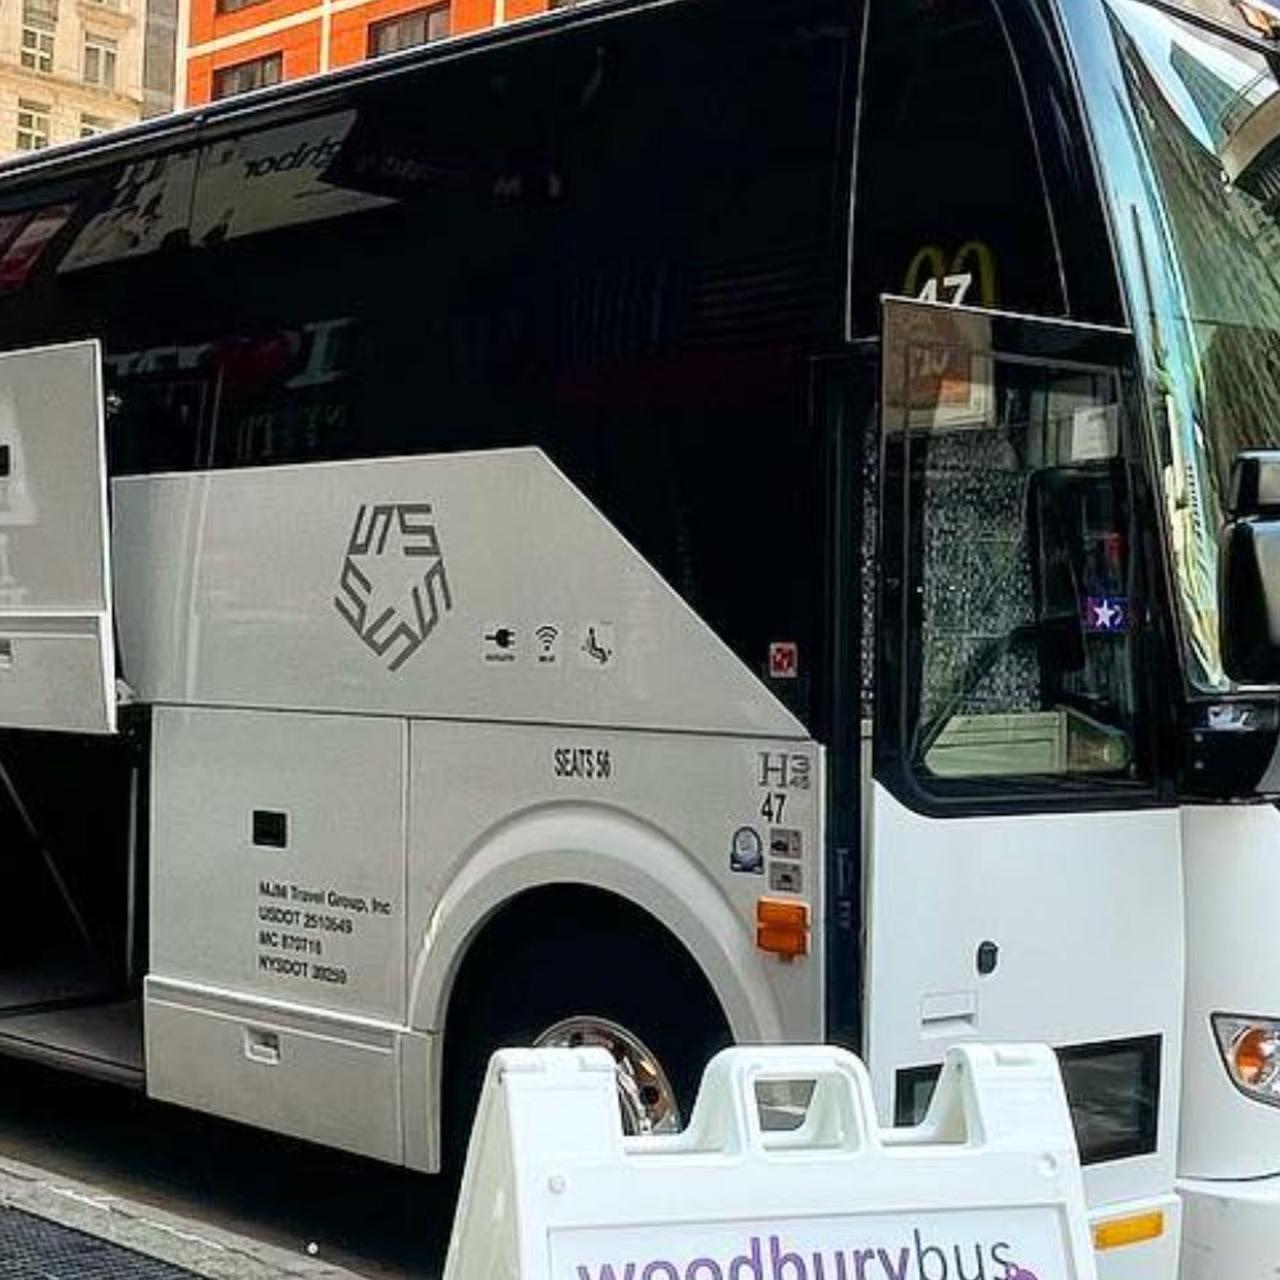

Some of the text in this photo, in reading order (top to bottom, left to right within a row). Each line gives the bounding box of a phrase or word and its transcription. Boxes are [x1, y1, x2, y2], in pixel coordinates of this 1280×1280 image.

[554, 747, 595, 779] SEATS
[760, 792, 787, 825] 47
[290, 885, 325, 905] Travel
[259, 905, 301, 926] USDOT
[259, 930, 279, 948] MC
